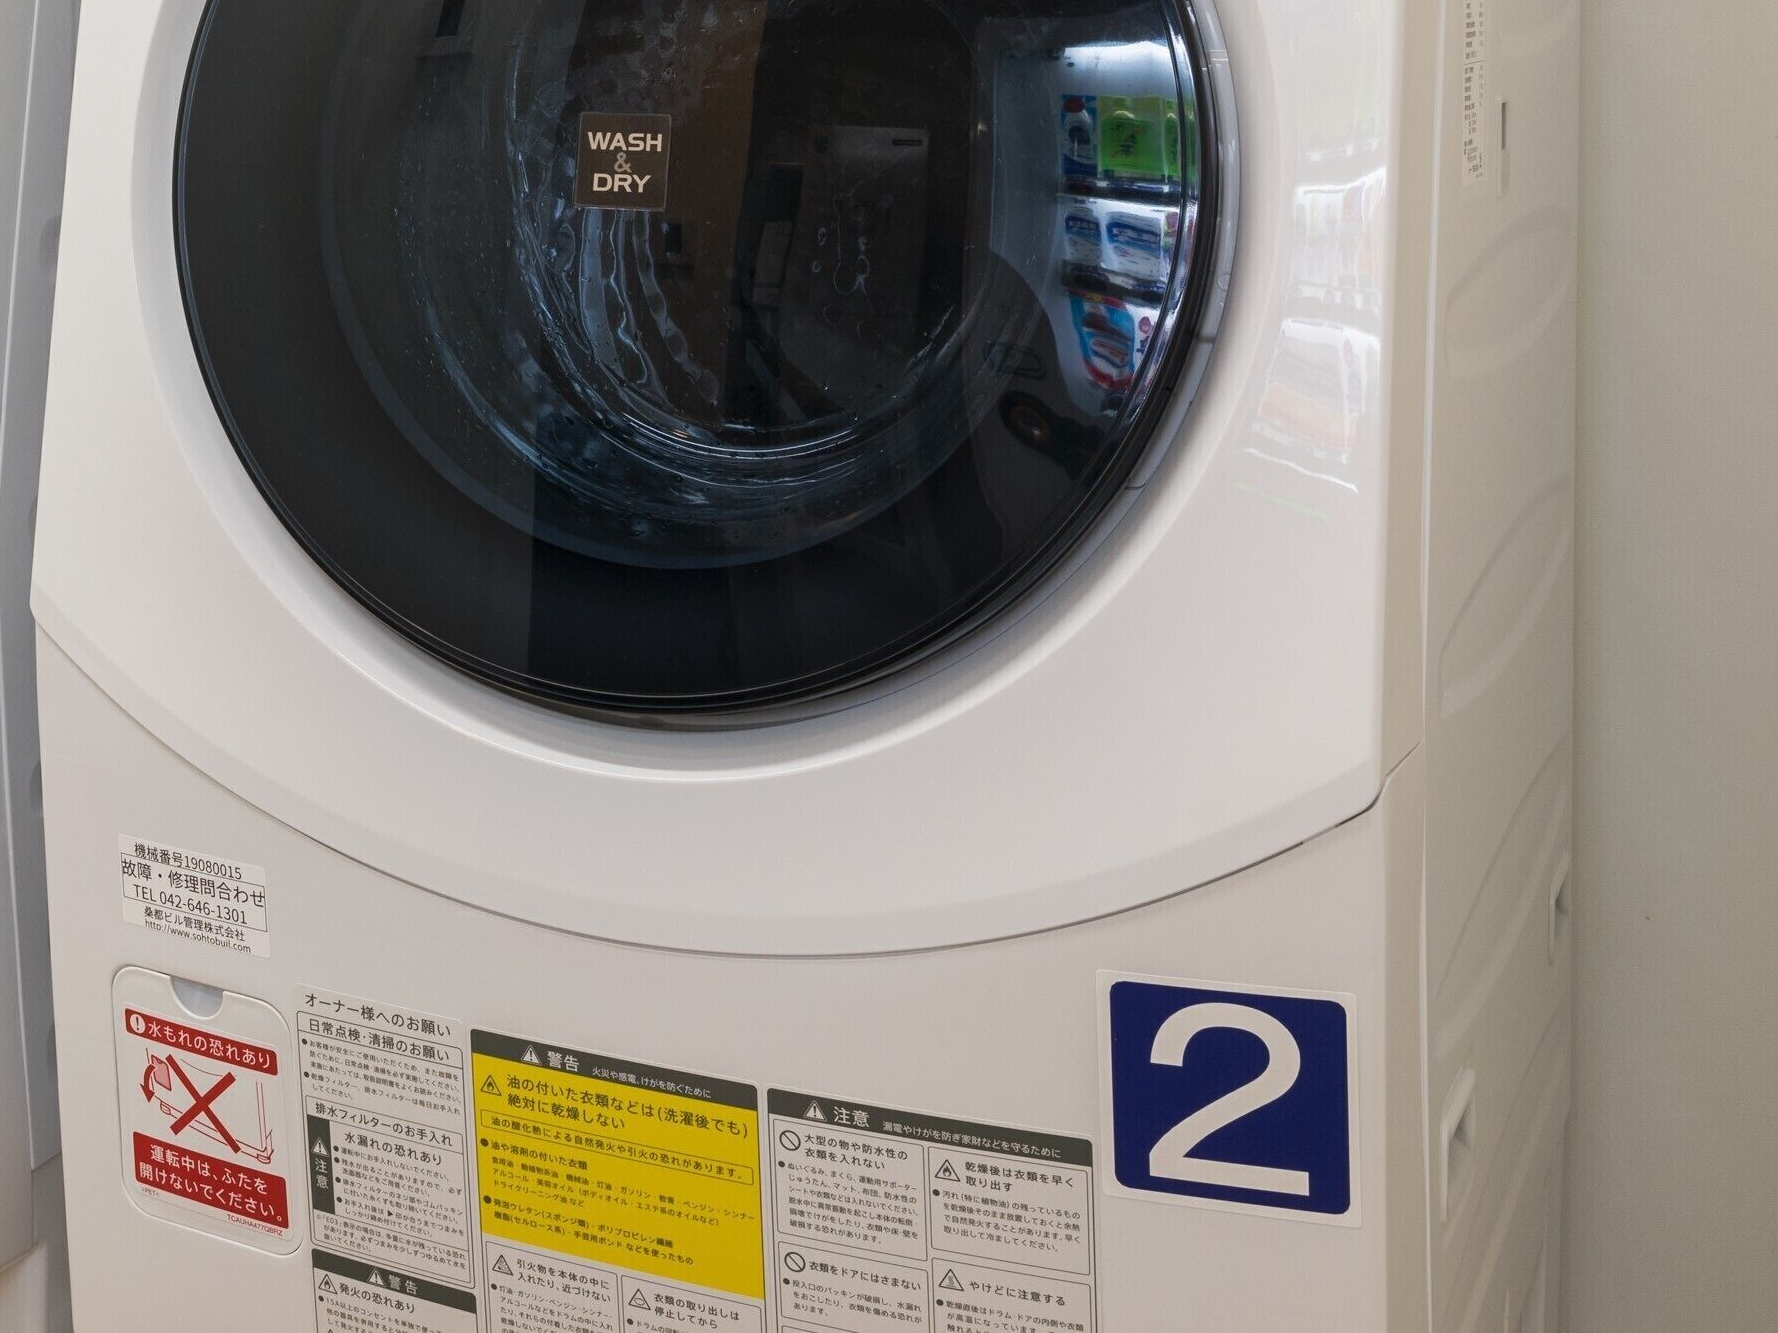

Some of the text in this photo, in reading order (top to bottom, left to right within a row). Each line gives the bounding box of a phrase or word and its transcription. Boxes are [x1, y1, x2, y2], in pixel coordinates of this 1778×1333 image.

[588, 132, 662, 152] WASH
[614, 152, 632, 172] &
[592, 173, 651, 193] DRY
[134, 842, 242, 879] 機械番号19080015
[122, 860, 265, 907] 故障・修理問合わせ
[134, 884, 247, 925] TEL 042-646-1301
[144, 906, 245, 941] 桑都ビル管理株式会社
[145, 919, 251, 953] http://www.sohtobuil.com
[304, 993, 451, 1037] オーナー様へのお願い
[148, 1022, 271, 1068] 水もれの恐れあり
[309, 1018, 450, 1061] 日常点検・清掃のお願い
[547, 1050, 711, 1098] 警告 火災や感電、けがを防ぐために
[507, 1074, 748, 1137] 油の付いた衣類などは(洗濯後でも)
[507, 1093, 625, 1130] 絶対に乾燥しない
[1149, 1002, 1309, 1196] 2
[315, 1101, 453, 1147] 排水フィルターのお手入れ
[833, 1106, 1061, 1158] 注意 漏電やけがを防ぎ家財などを守るために
[344, 1131, 443, 1166] 水漏れの恐れあり
[491, 1141, 588, 1170] 油や溶剤の付いた衣類
[804, 1133, 908, 1160] 大型の物や防水性の
[805, 1148, 886, 1169] 衣類を入れない
[150, 1143, 268, 1195] 運転中は、ふたを
[965, 1160, 1074, 1188] 乾燥後は衣類を早く
[966, 1175, 1014, 1191] 取り出す
[139, 1162, 282, 1222] 開けないでください。
[388, 1273, 418, 1295] 警告
[516, 1259, 610, 1289] 引火物を本体の中に
[518, 1273, 611, 1303] 入れたり、近づけない
[809, 1260, 921, 1290] 衣類をドアにはさまない
[970, 1280, 1066, 1306] やけどに注意する
